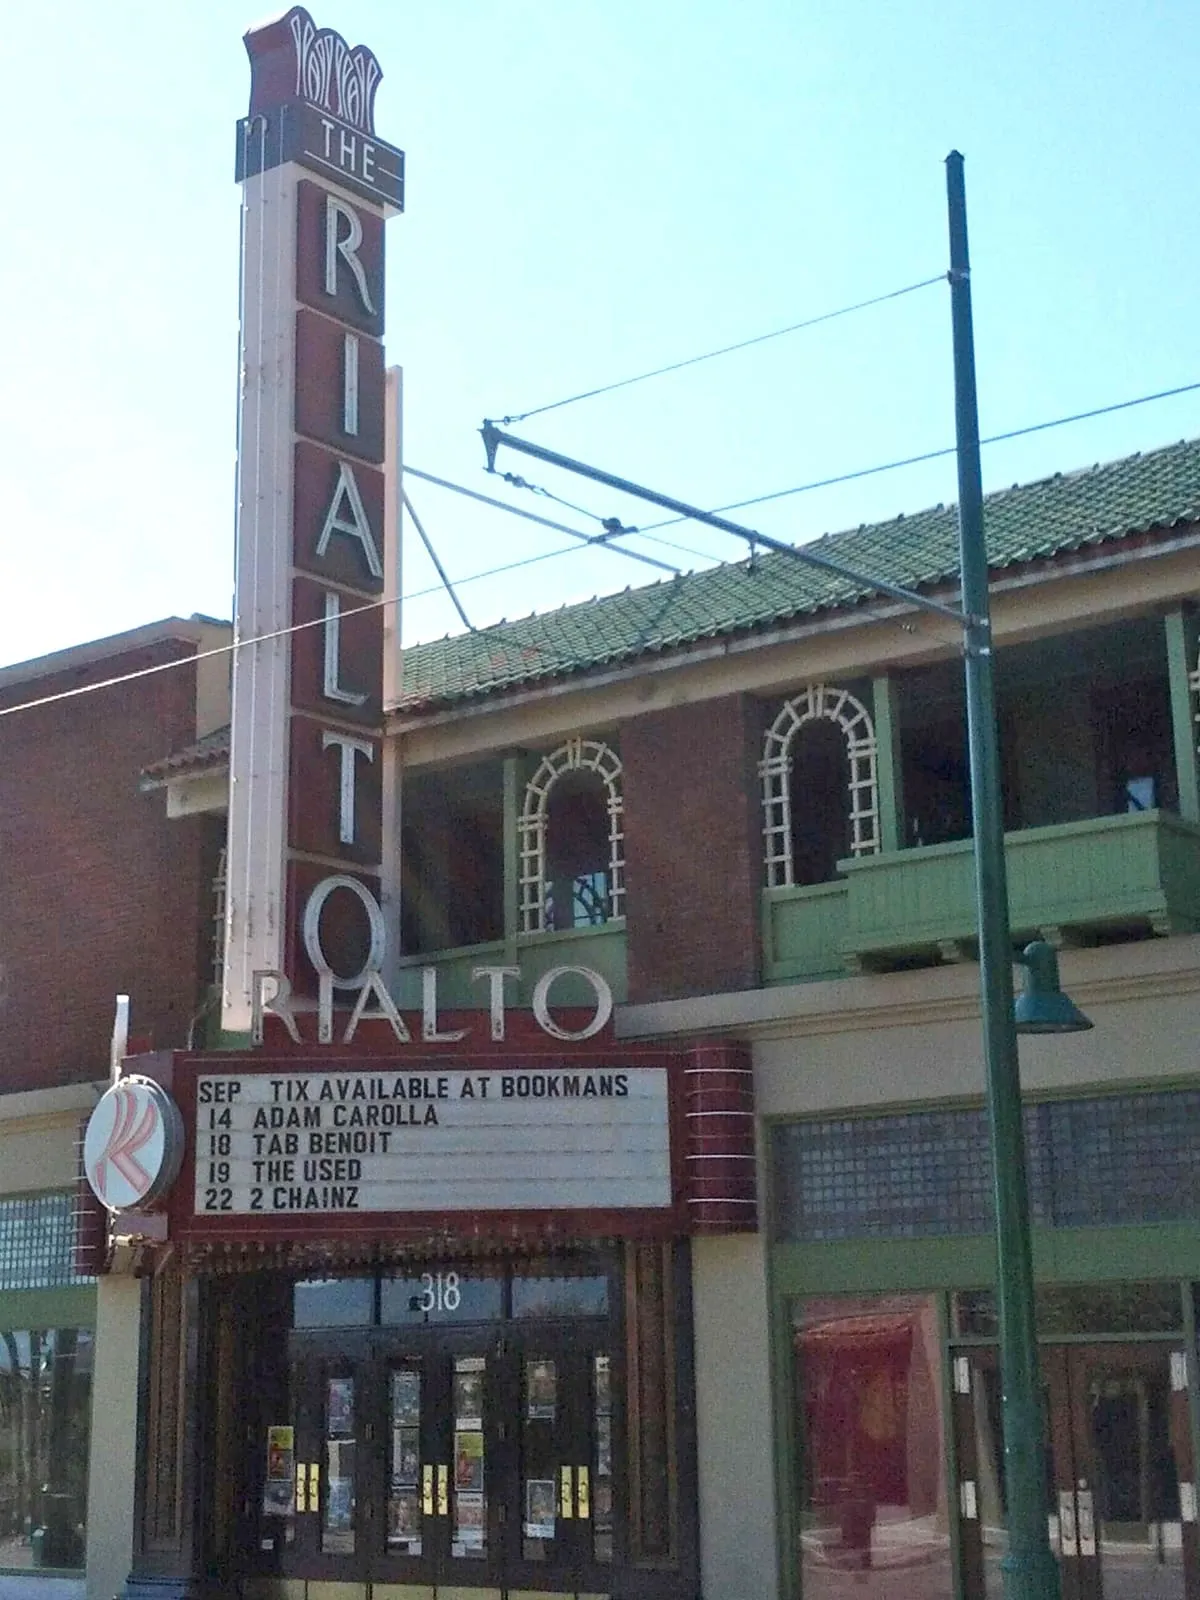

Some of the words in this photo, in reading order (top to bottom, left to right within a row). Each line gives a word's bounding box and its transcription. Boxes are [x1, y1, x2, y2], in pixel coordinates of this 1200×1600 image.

[321, 118, 375, 182] THE
[304, 193, 386, 990] RIALTO
[251, 965, 613, 1047] RIALTO
[199, 1080, 242, 1103] SEP
[270, 1079, 310, 1102] TIX
[319, 1077, 449, 1101] AVAILABLE
[460, 1076, 490, 1098] AT
[501, 1074, 629, 1098] BOOKMANS
[209, 1107, 233, 1130] 14
[253, 1106, 321, 1129] ADAM
[333, 1103, 439, 1127] CAROLLA
[210, 1133, 231, 1156] 18
[252, 1132, 299, 1155] TAB
[309, 1131, 393, 1154] BENOIT
[208, 1161, 230, 1184] 19
[252, 1160, 294, 1182] THE
[303, 1158, 362, 1181] USED
[205, 1188, 233, 1211] 22
[250, 1187, 264, 1210] 2
[273, 1186, 359, 1209] CHAINZ
[420, 1270, 461, 1311] 318
